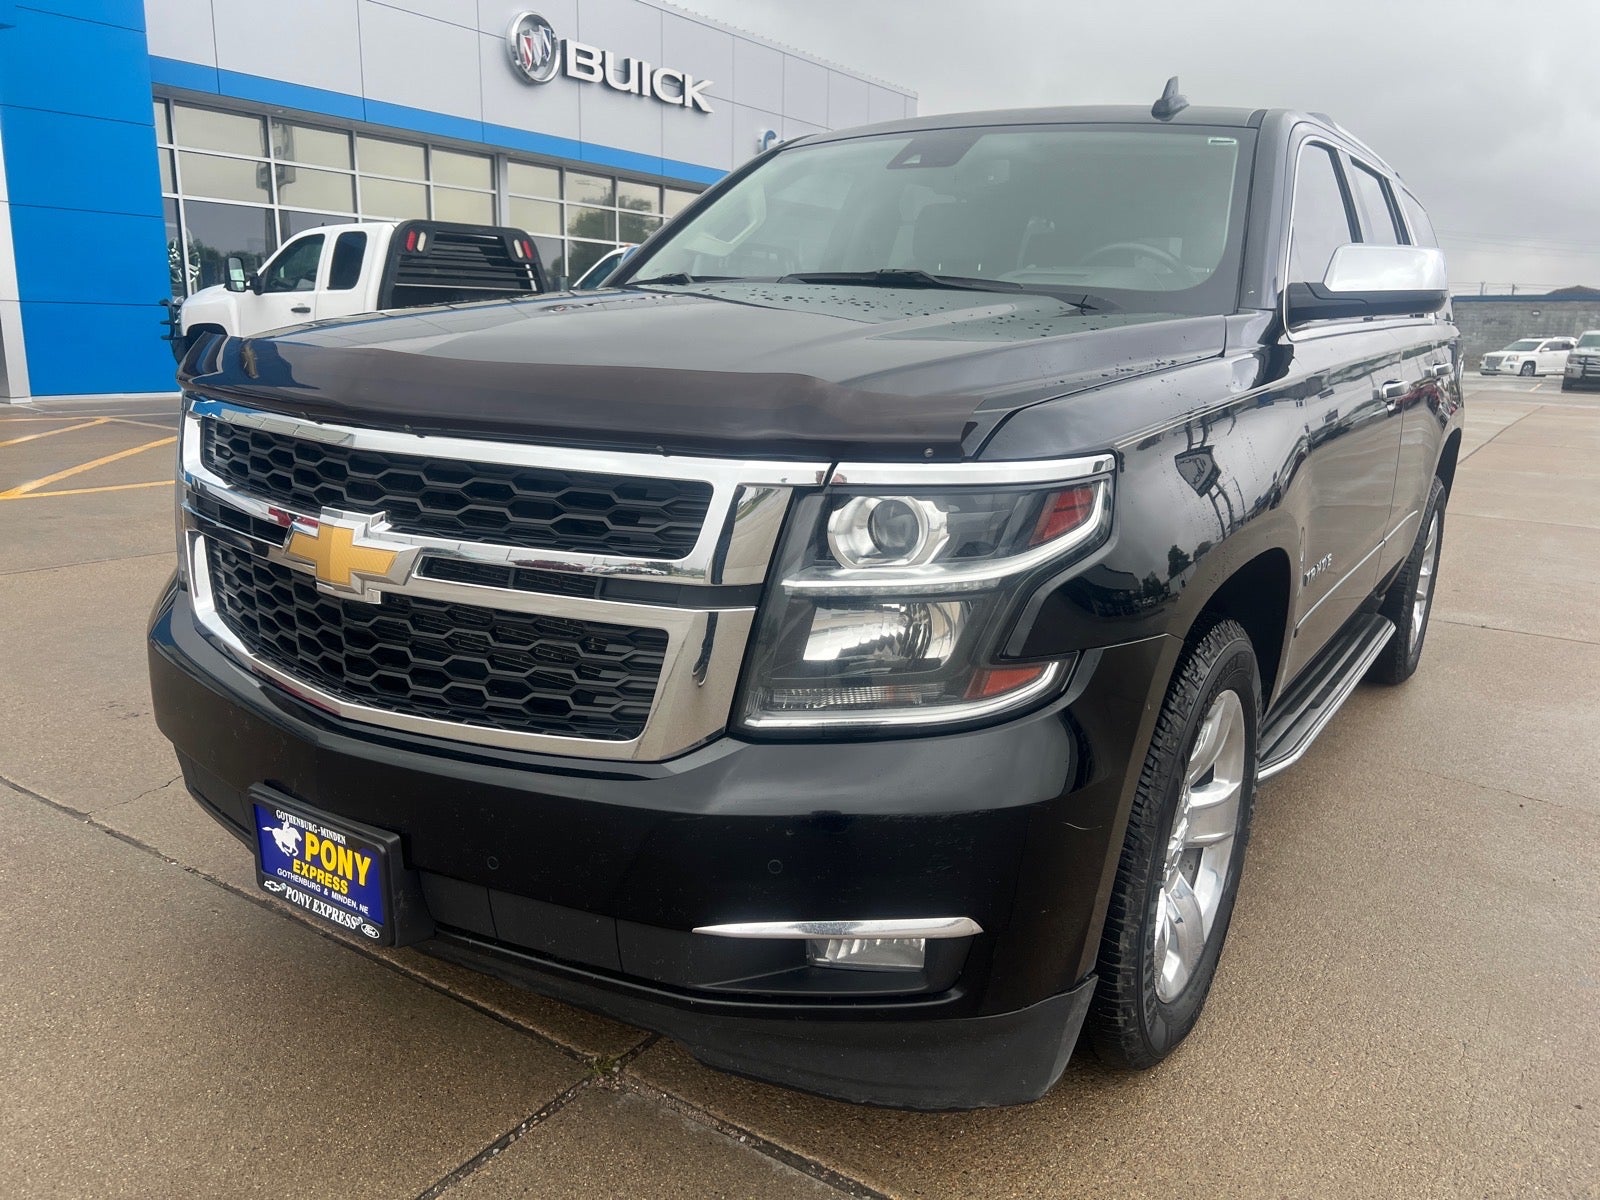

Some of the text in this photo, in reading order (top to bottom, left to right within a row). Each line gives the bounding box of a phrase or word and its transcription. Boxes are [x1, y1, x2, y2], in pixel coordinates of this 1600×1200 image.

[563, 38, 714, 113] BUICK
[276, 809, 346, 845] GOTHENBURG-MINDEN
[293, 858, 349, 895] EXPRESS
[305, 831, 372, 886] PONY
[277, 868, 321, 892] GOTHENBURG
[323, 888, 329, 896] &
[359, 905, 369, 915] NE
[285, 886, 357, 930] PONY EXPRESS
